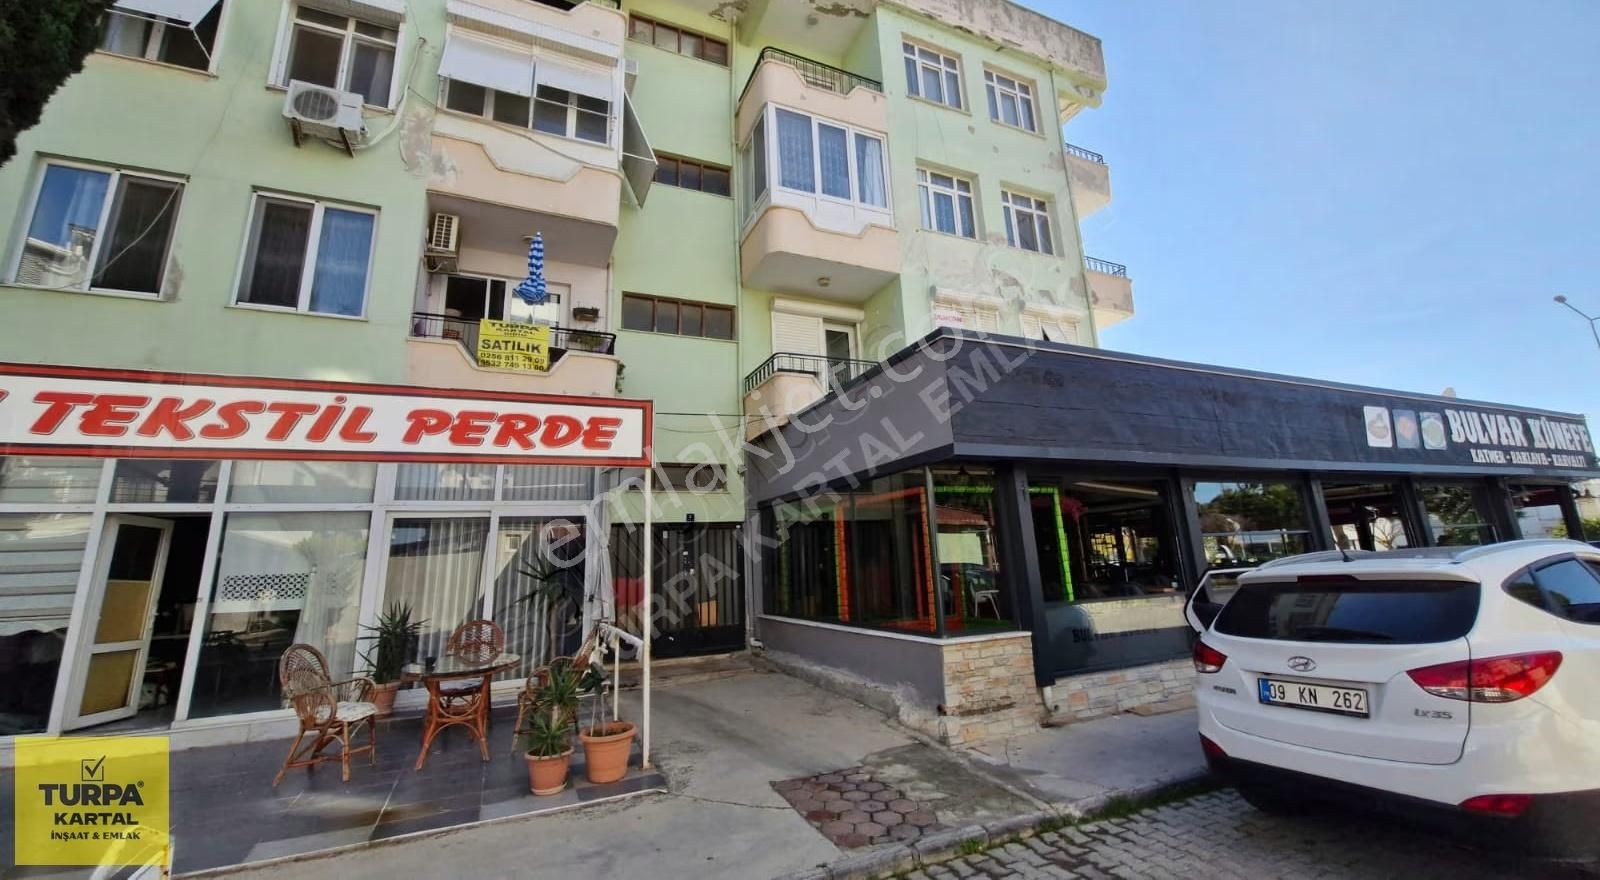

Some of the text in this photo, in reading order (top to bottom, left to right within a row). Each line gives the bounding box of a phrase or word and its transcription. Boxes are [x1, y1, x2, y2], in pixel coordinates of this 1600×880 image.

[481, 339, 541, 353] SATILIK
[28, 391, 623, 450] TEKSTİL PERDE
[1444, 409, 1593, 452] BULVAR KÜNEFE
[1269, 684, 1364, 711] 09 KN 262
